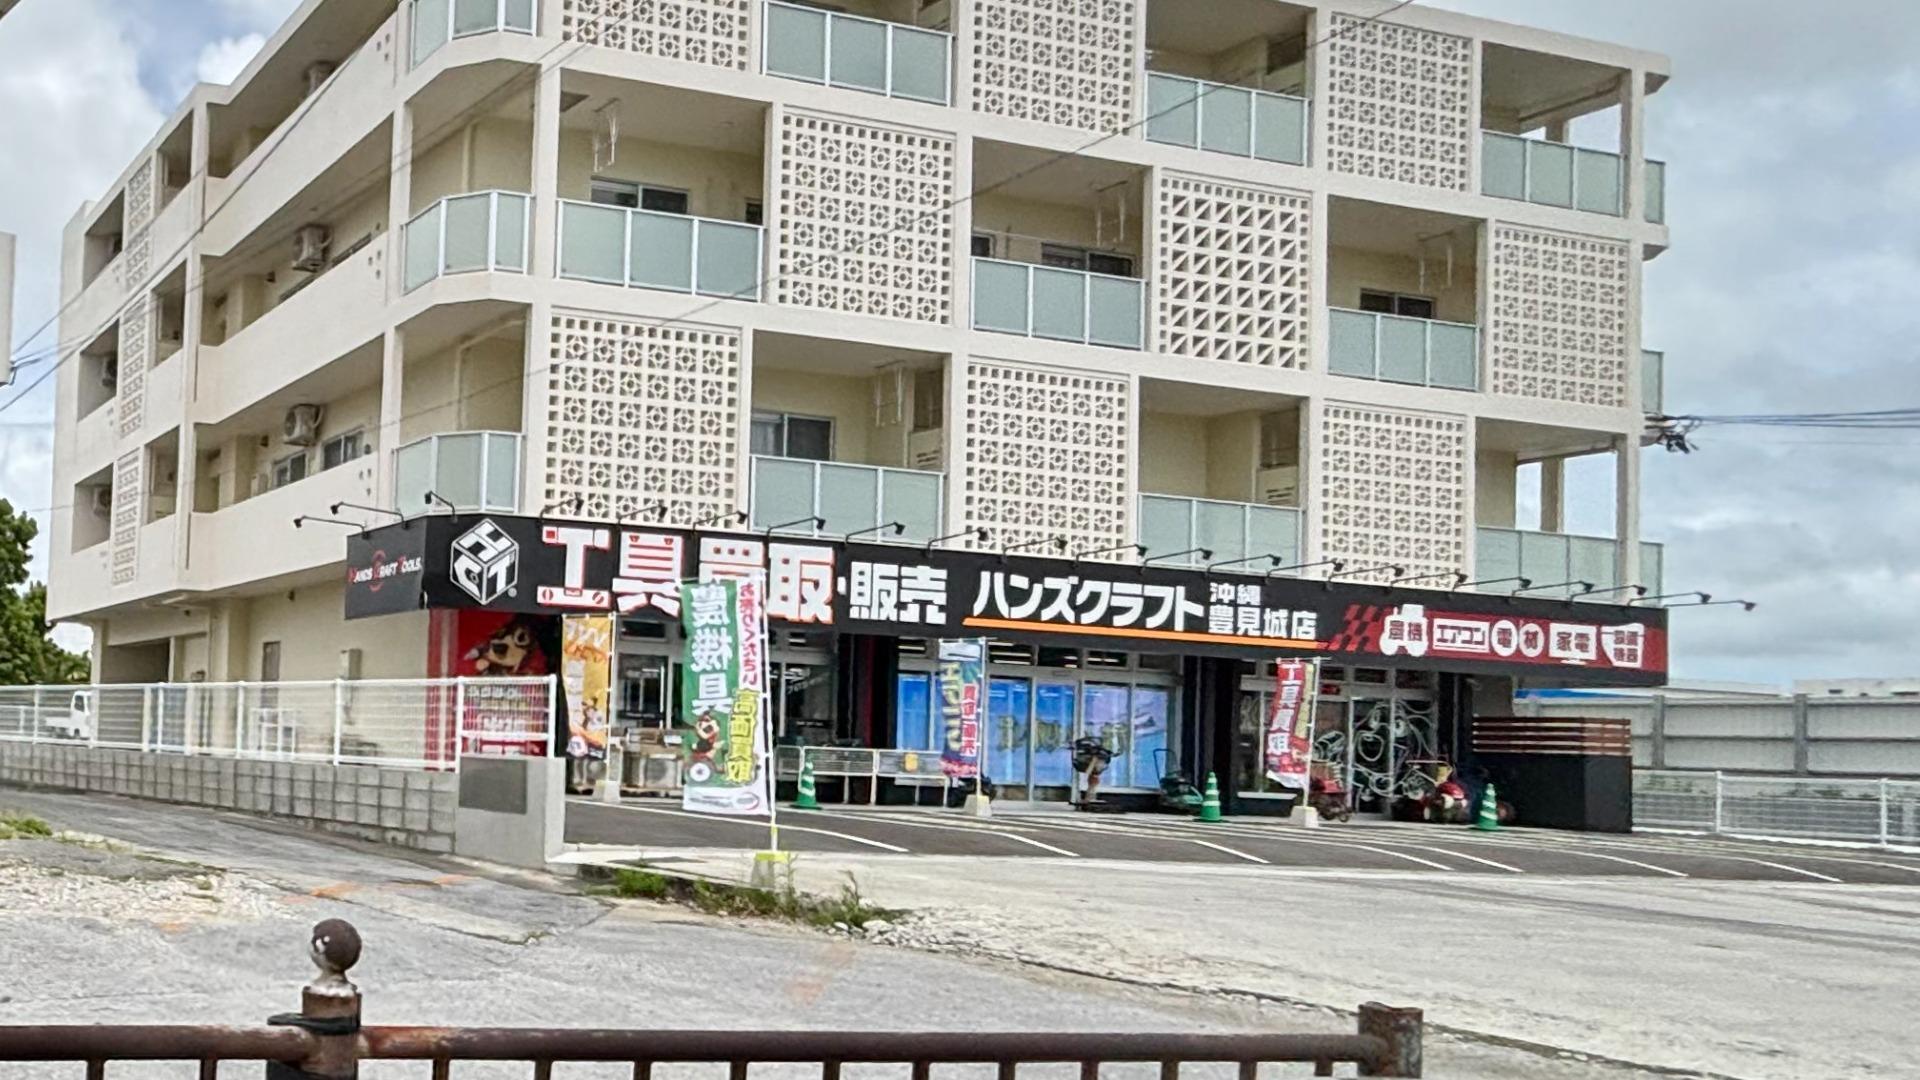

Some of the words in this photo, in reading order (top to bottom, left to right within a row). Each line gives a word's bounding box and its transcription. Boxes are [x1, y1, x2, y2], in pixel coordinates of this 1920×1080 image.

[973, 571, 1204, 632] ハンズクラフト
[1209, 582, 1262, 605] 沖縄
[1208, 605, 1317, 640] 豊見城店
[1436, 624, 1486, 646] エアコン
[690, 582, 733, 716] 農機具
[1556, 631, 1591, 652] 家電
